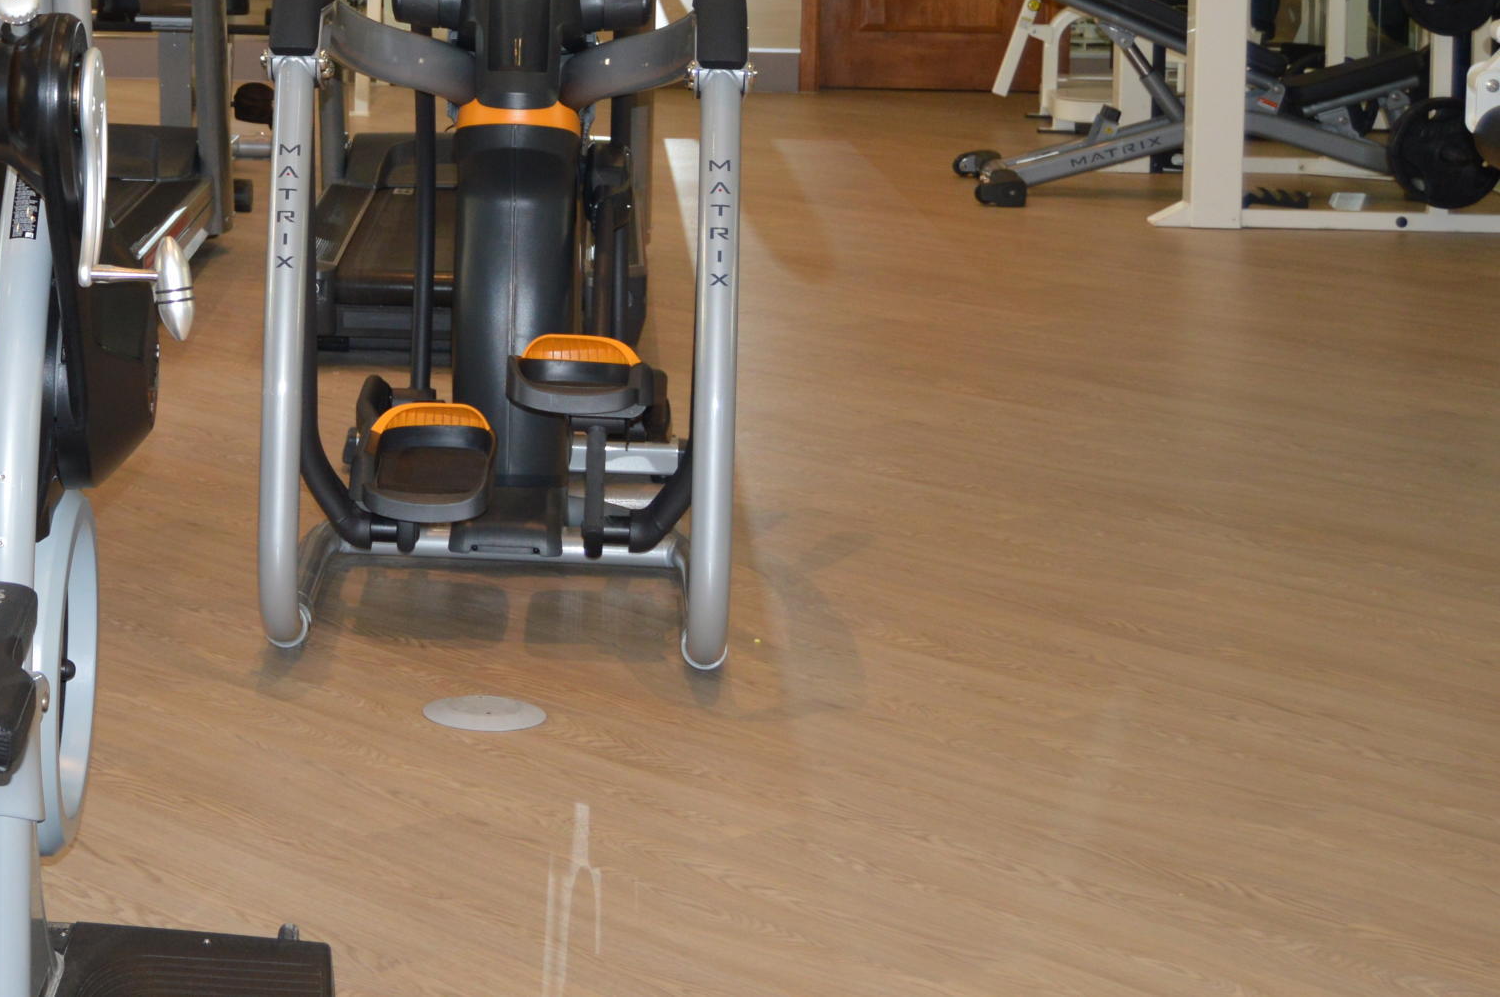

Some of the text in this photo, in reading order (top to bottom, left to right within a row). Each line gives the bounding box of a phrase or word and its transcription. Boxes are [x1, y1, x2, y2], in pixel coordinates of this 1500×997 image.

[276, 143, 301, 269] MATRIX
[1070, 135, 1162, 168] MATRIX
[708, 159, 731, 287] MATRIX
